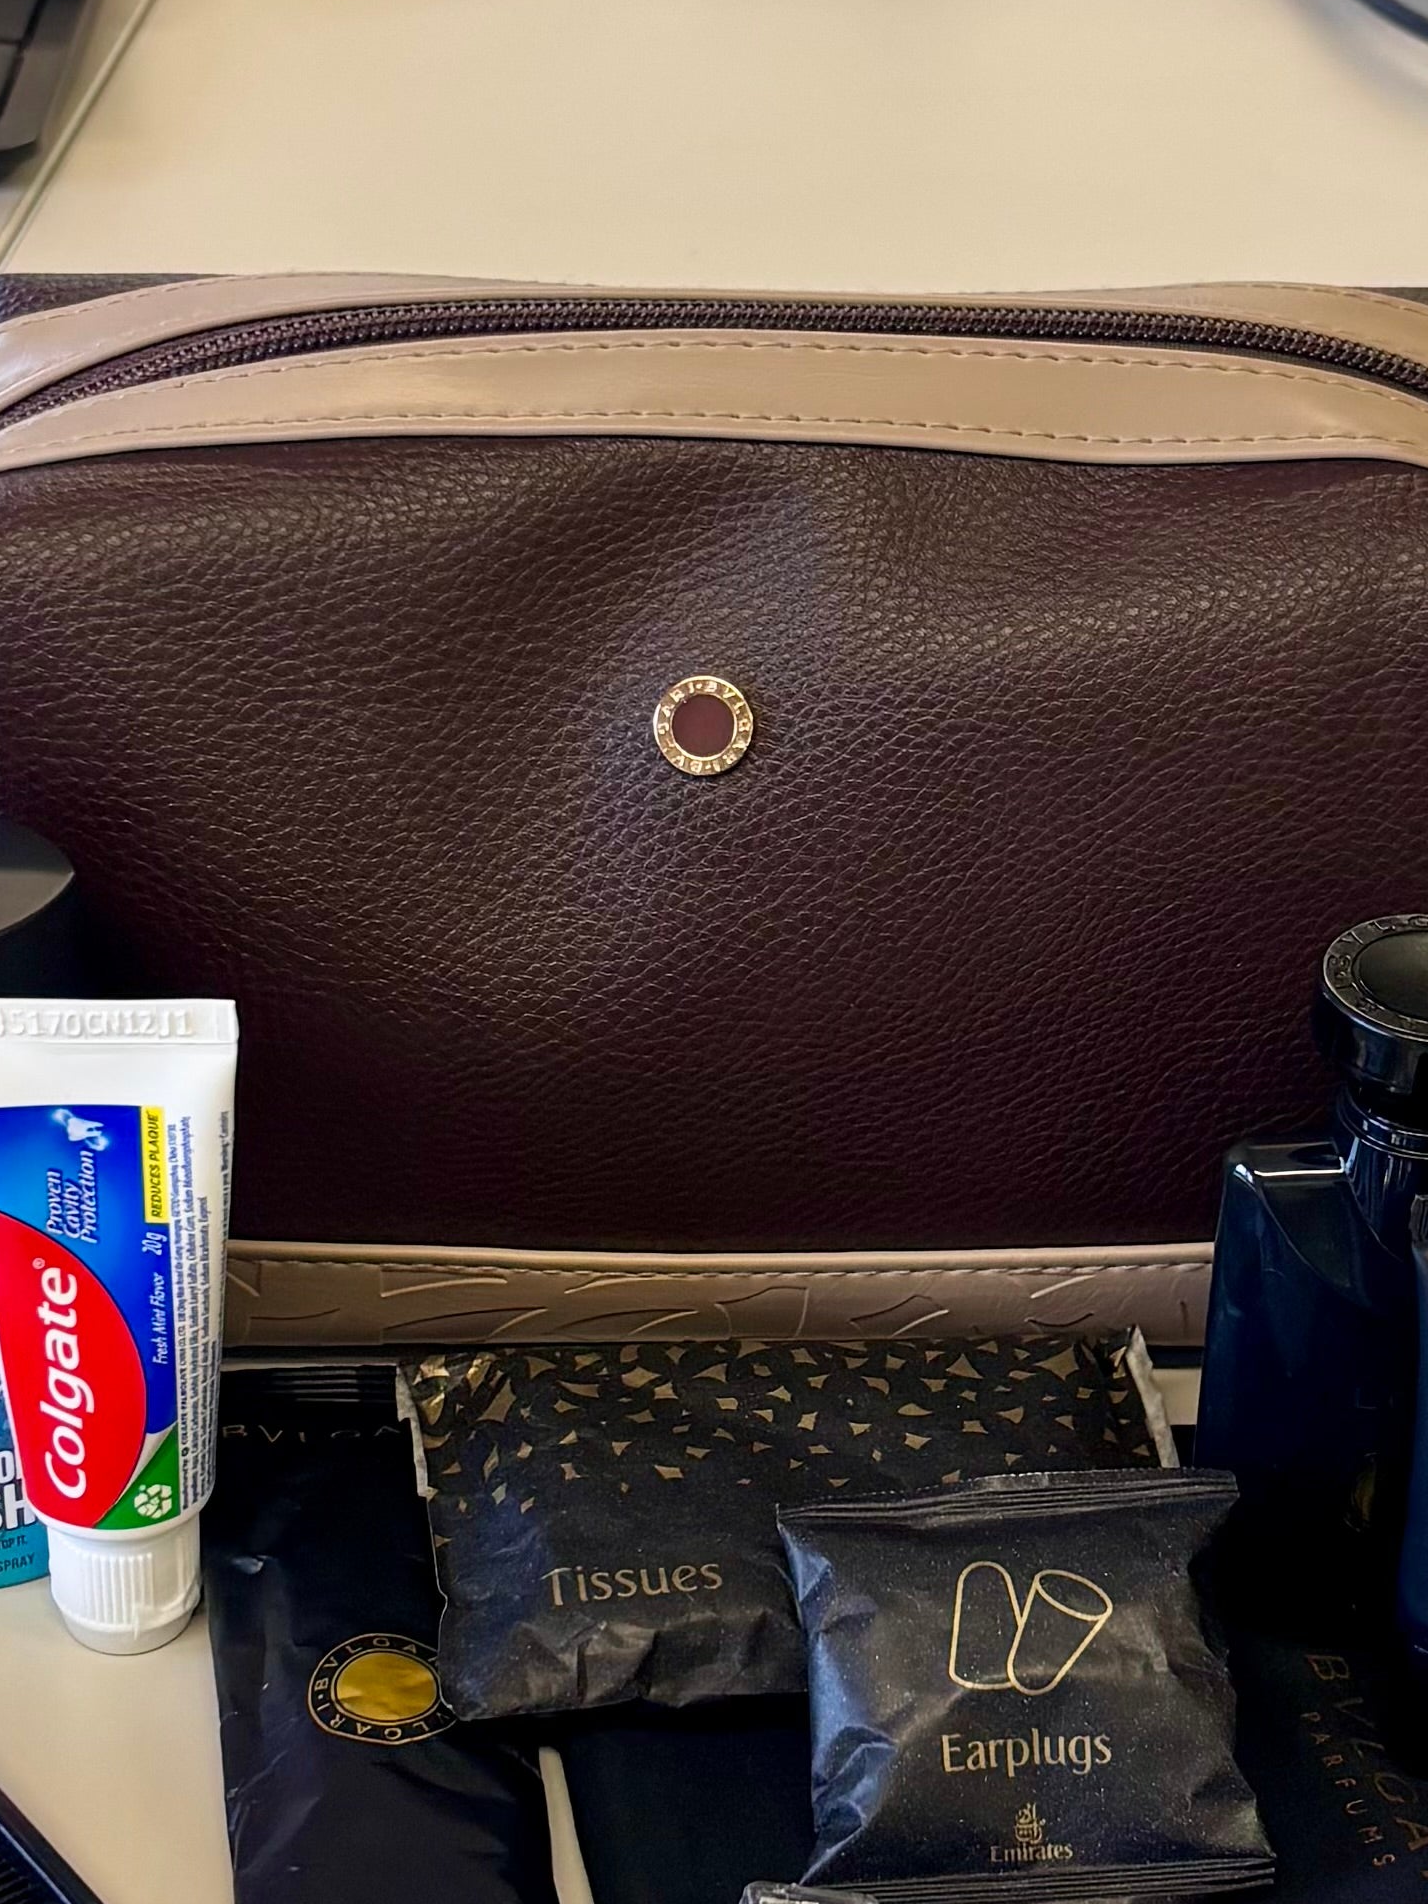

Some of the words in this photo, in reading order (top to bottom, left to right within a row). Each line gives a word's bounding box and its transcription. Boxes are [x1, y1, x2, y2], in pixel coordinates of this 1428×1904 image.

[46, 1170, 62, 1236] Proven
[62, 1180, 82, 1240] Cavity
[79, 1149, 99, 1245] Protection
[148, 1163, 163, 1219] REDUCES
[141, 1231, 168, 1256] 20g
[149, 1271, 168, 1308] Flavor
[151, 1309, 168, 1335] Mint
[151, 1337, 169, 1365] Fresh
[37, 1266, 95, 1499] Colgate
[539, 1562, 723, 1606] Tissues
[941, 1727, 1113, 1779] Earplugs
[1299, 1710, 1397, 1869] PARFUMS
[990, 1843, 1074, 1863] Emirates
